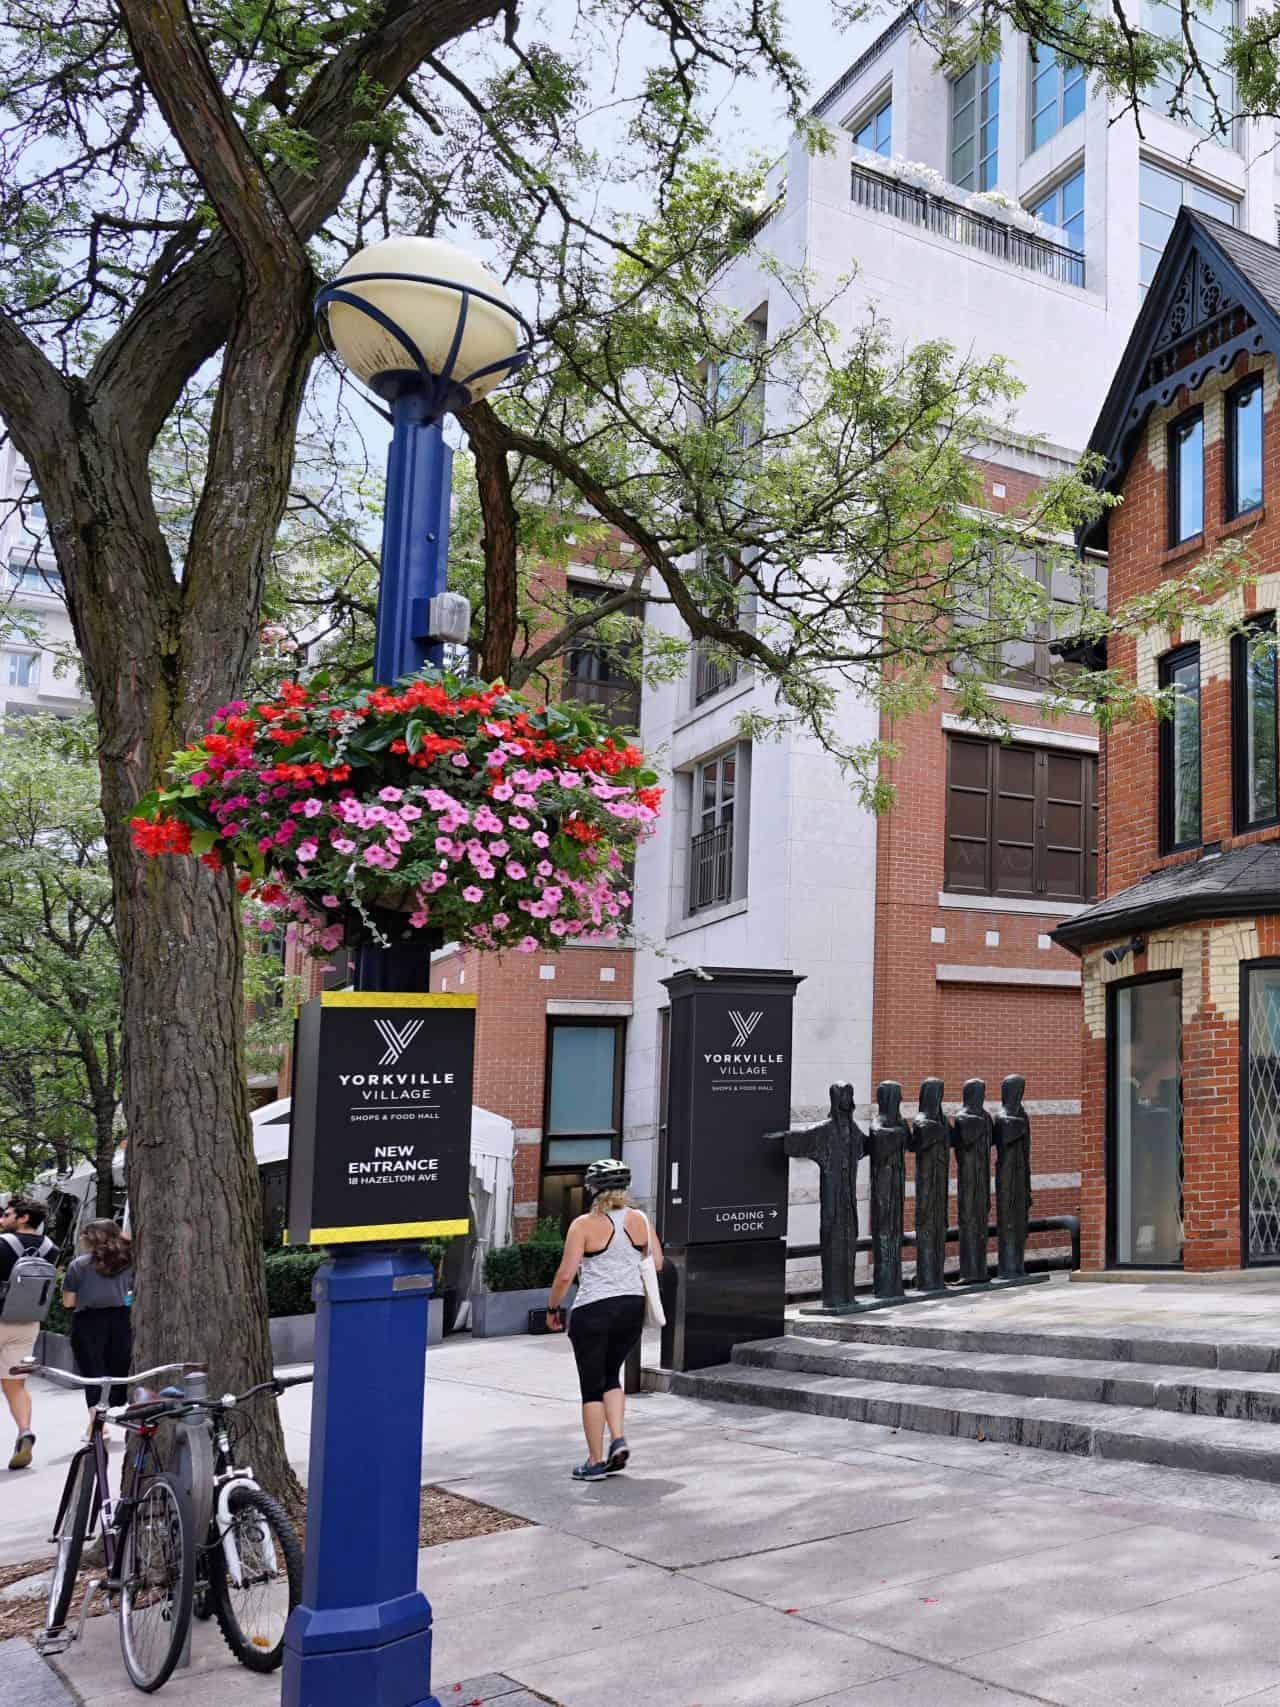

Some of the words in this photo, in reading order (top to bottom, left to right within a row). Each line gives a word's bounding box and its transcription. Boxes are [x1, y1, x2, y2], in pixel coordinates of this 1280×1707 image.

[703, 1054, 784, 1063] YORKVILLE
[720, 1066, 768, 1075] VILLAGE
[339, 1073, 455, 1086] YORKVILLE
[362, 1089, 432, 1100] VILLAGE
[351, 1113, 379, 1121] SHOPS
[375, 1145, 414, 1158] NEW
[348, 1158, 440, 1174] ENTRANCE
[360, 1174, 415, 1184] HAZELTON
[417, 1172, 439, 1181] AVE
[716, 1210, 764, 1222] LOADING
[733, 1222, 764, 1232] DOCK
